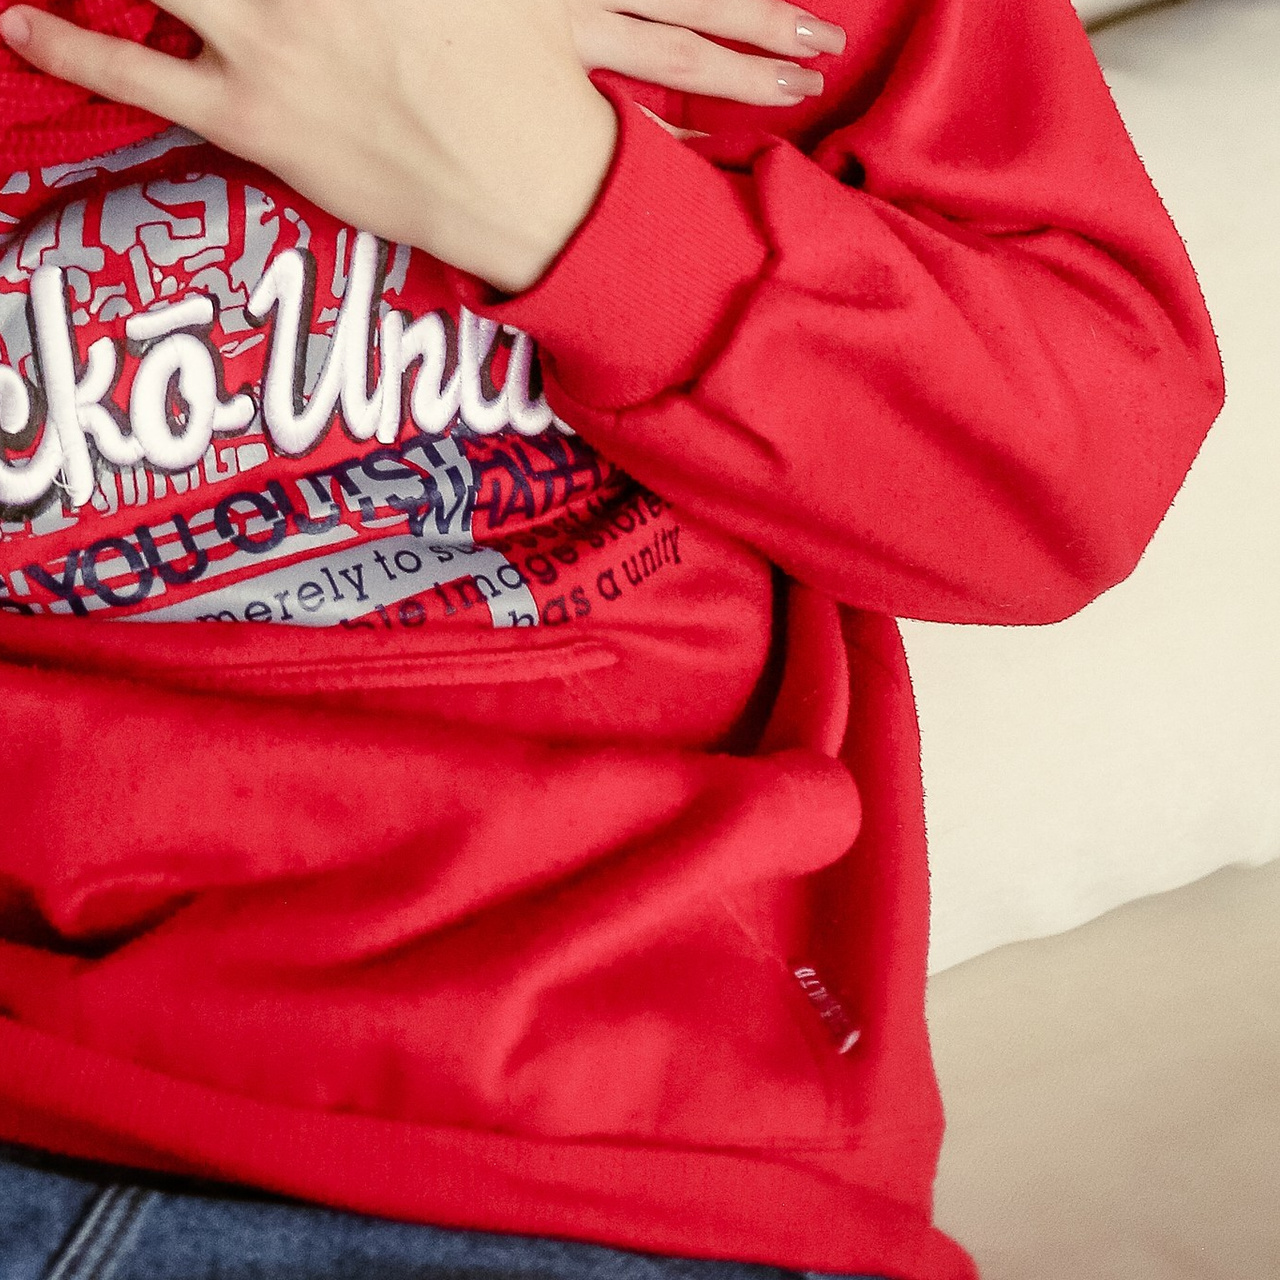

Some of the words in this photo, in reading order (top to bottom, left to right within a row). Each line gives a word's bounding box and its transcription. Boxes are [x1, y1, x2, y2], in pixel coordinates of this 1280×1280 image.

[23, 513, 209, 618] YOU
[195, 561, 371, 624] merely
[374, 546, 423, 581] to
[432, 538, 580, 616] image
[508, 584, 592, 627] has
[596, 567, 623, 602] a
[621, 524, 682, 587] unity
